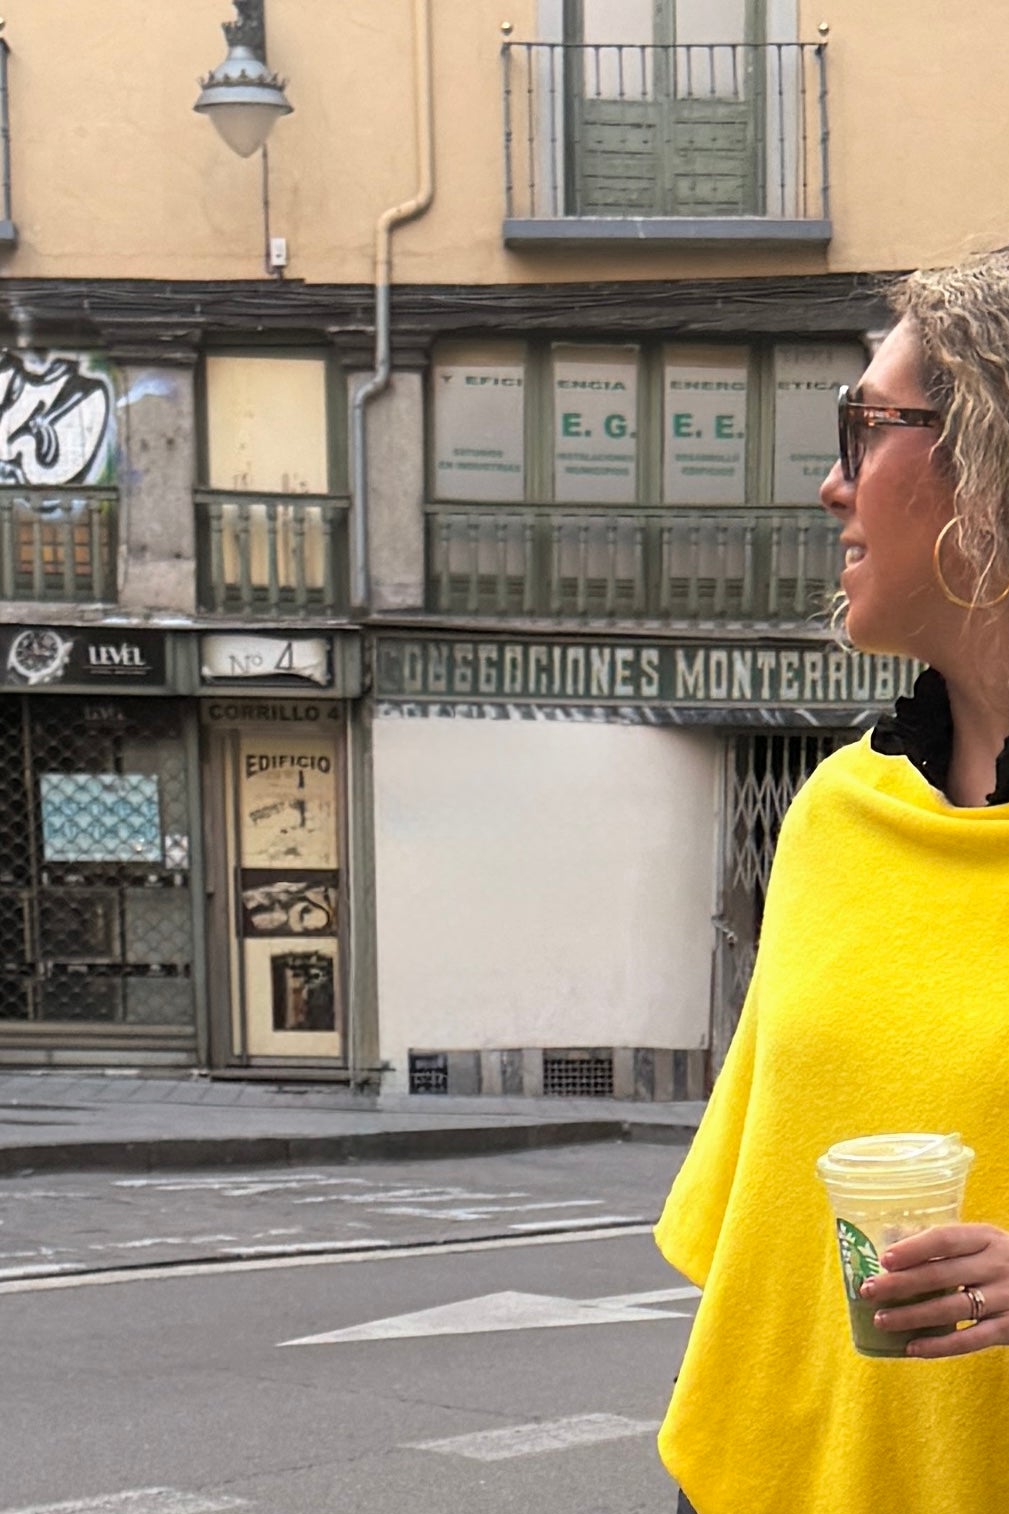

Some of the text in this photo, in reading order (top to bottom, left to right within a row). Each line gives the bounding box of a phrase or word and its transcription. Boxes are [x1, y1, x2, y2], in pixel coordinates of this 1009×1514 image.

[557, 380, 626, 391] ENCIA
[274, 642, 294, 671] 4
[209, 704, 338, 722] CORRILLO 4
[246, 754, 331, 778] EDIFICIO
